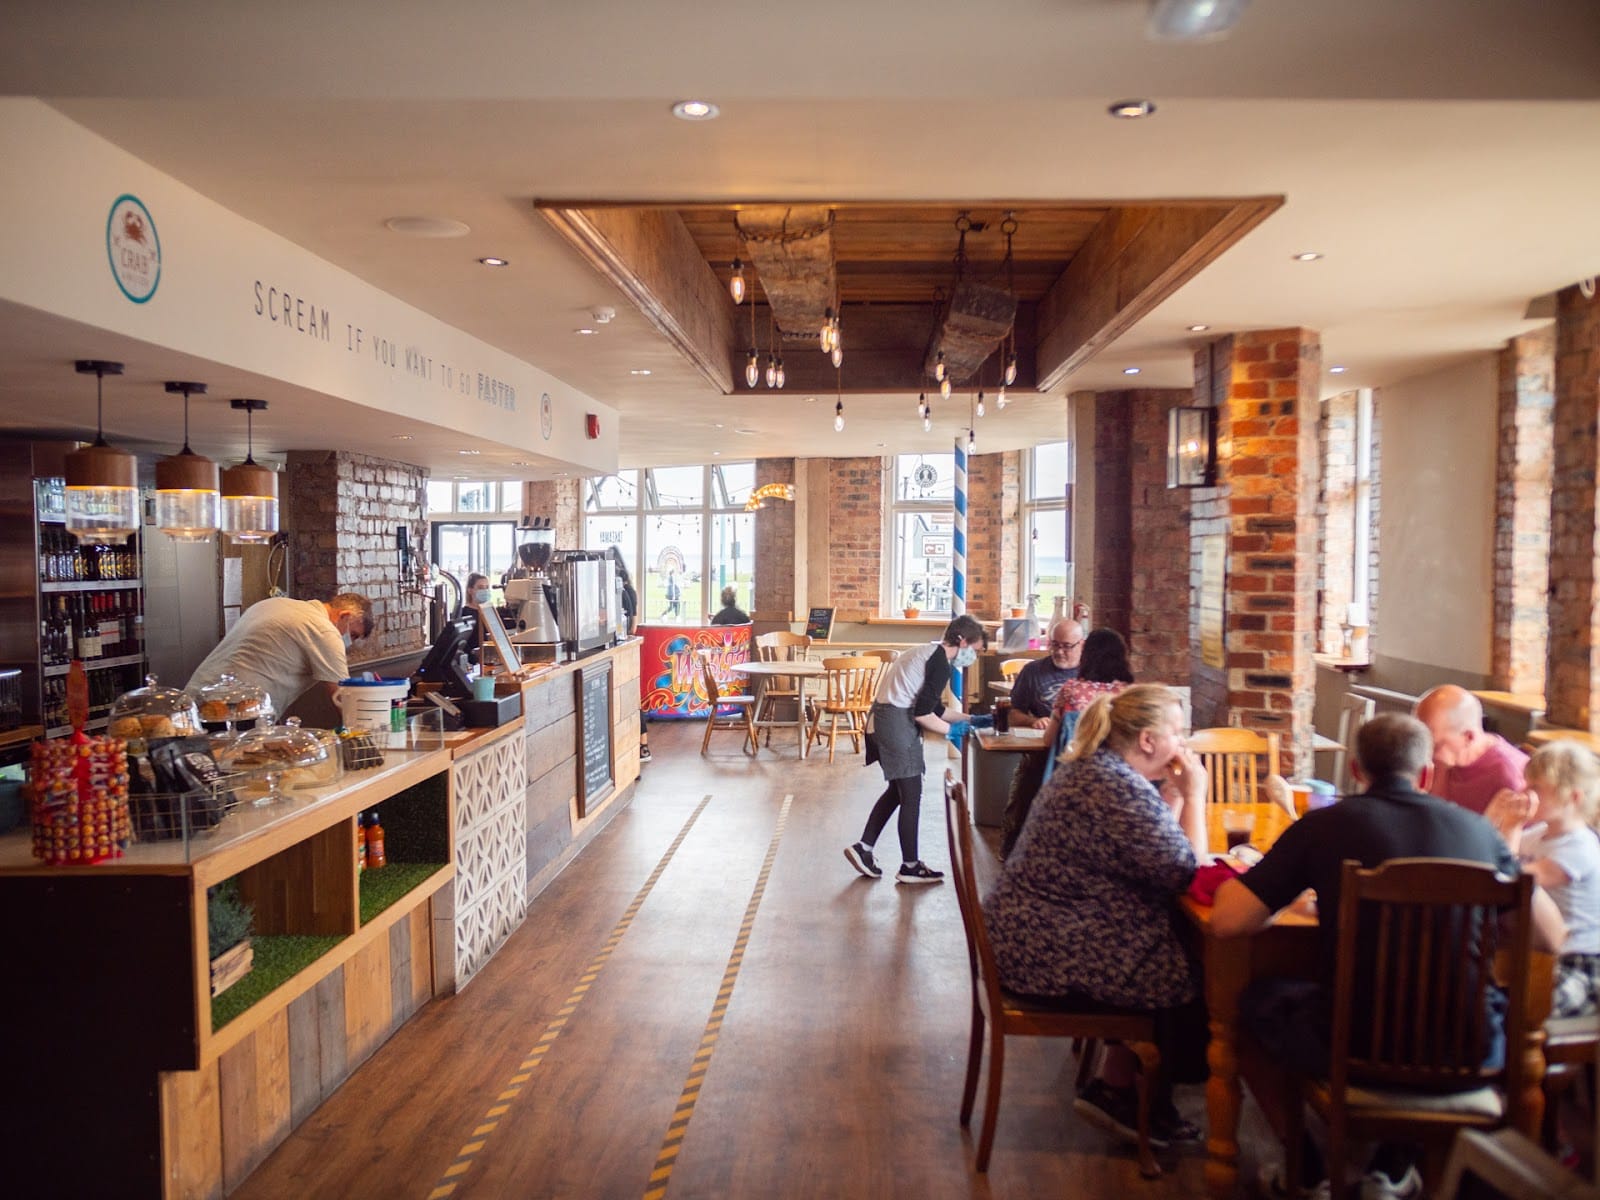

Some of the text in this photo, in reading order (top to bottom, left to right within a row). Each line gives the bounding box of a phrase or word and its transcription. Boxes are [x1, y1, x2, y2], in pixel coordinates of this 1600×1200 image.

[120, 247, 149, 274] CRAB
[254, 280, 515, 411] SCREAM IF YOU WANT TO GO FASTER
